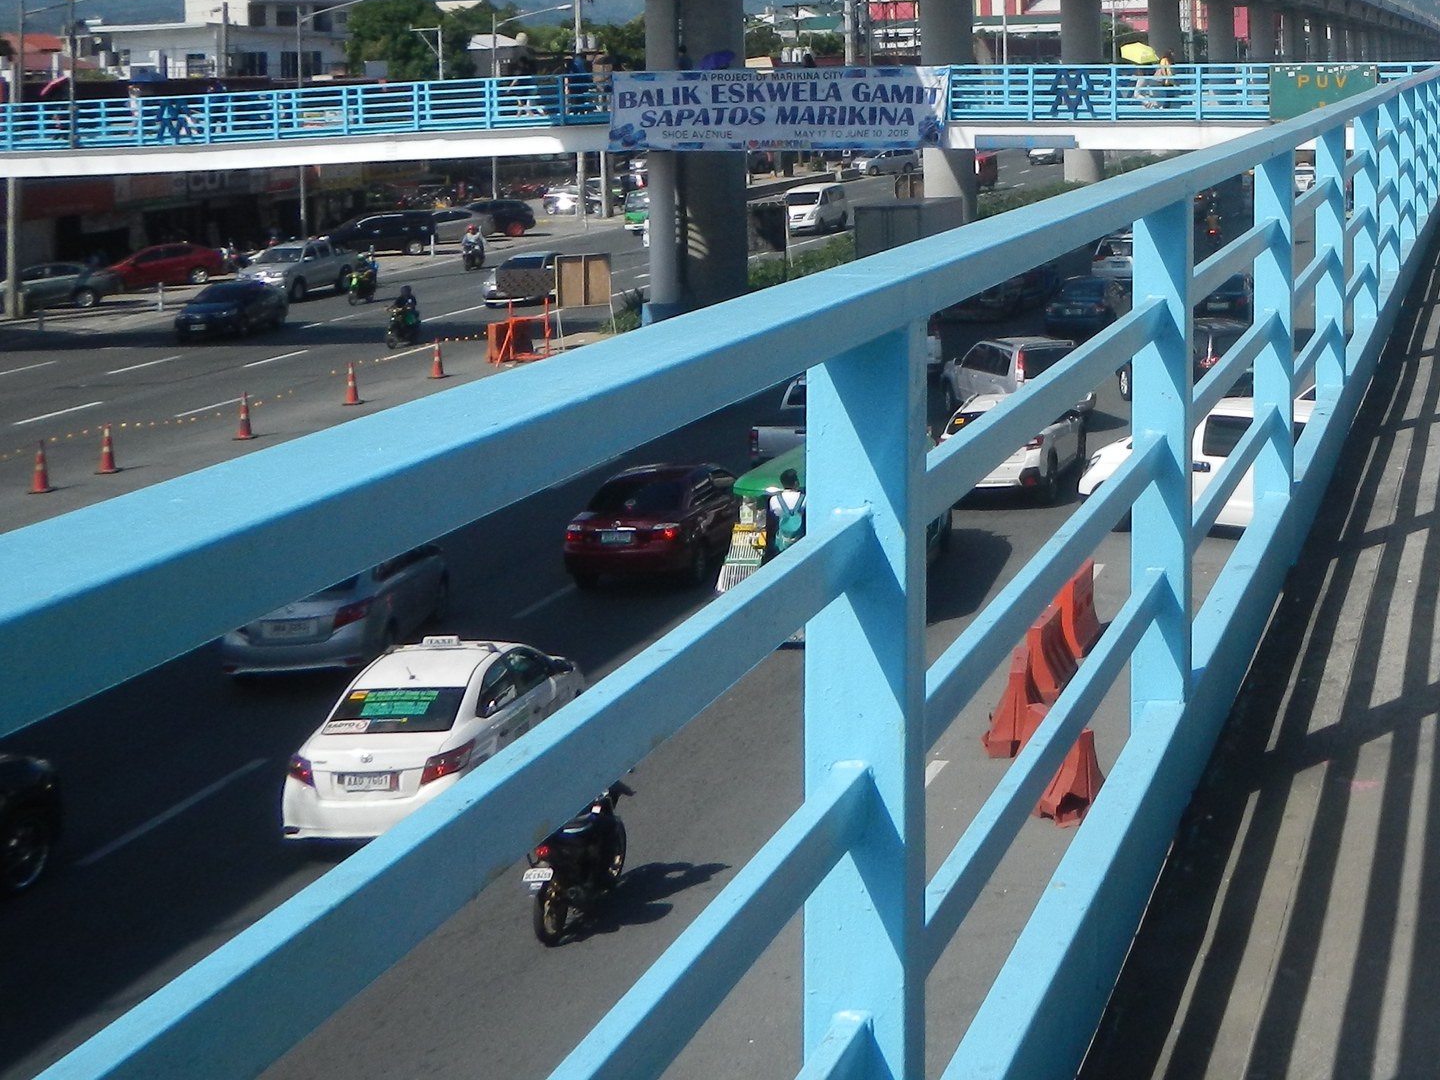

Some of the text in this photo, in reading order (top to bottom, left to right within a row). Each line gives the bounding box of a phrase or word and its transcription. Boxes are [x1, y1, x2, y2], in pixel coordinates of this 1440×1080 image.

[711, 73, 753, 82] PROJECT
[756, 73, 768, 81] OF
[771, 71, 820, 81] MARIKINA
[823, 71, 845, 80] CITY
[618, 82, 943, 109] BALIK ESKWELA GAMIT
[640, 105, 915, 128] SAPATOS MARIKINA
[662, 130, 689, 140] SHOE
[692, 130, 733, 139] AVENUE
[794, 130, 815, 138] MAY
[818, 130, 827, 138] 17
[830, 130, 843, 138] TO
[845, 129, 869, 138] JUNE
[887, 129, 909, 137] 2018
